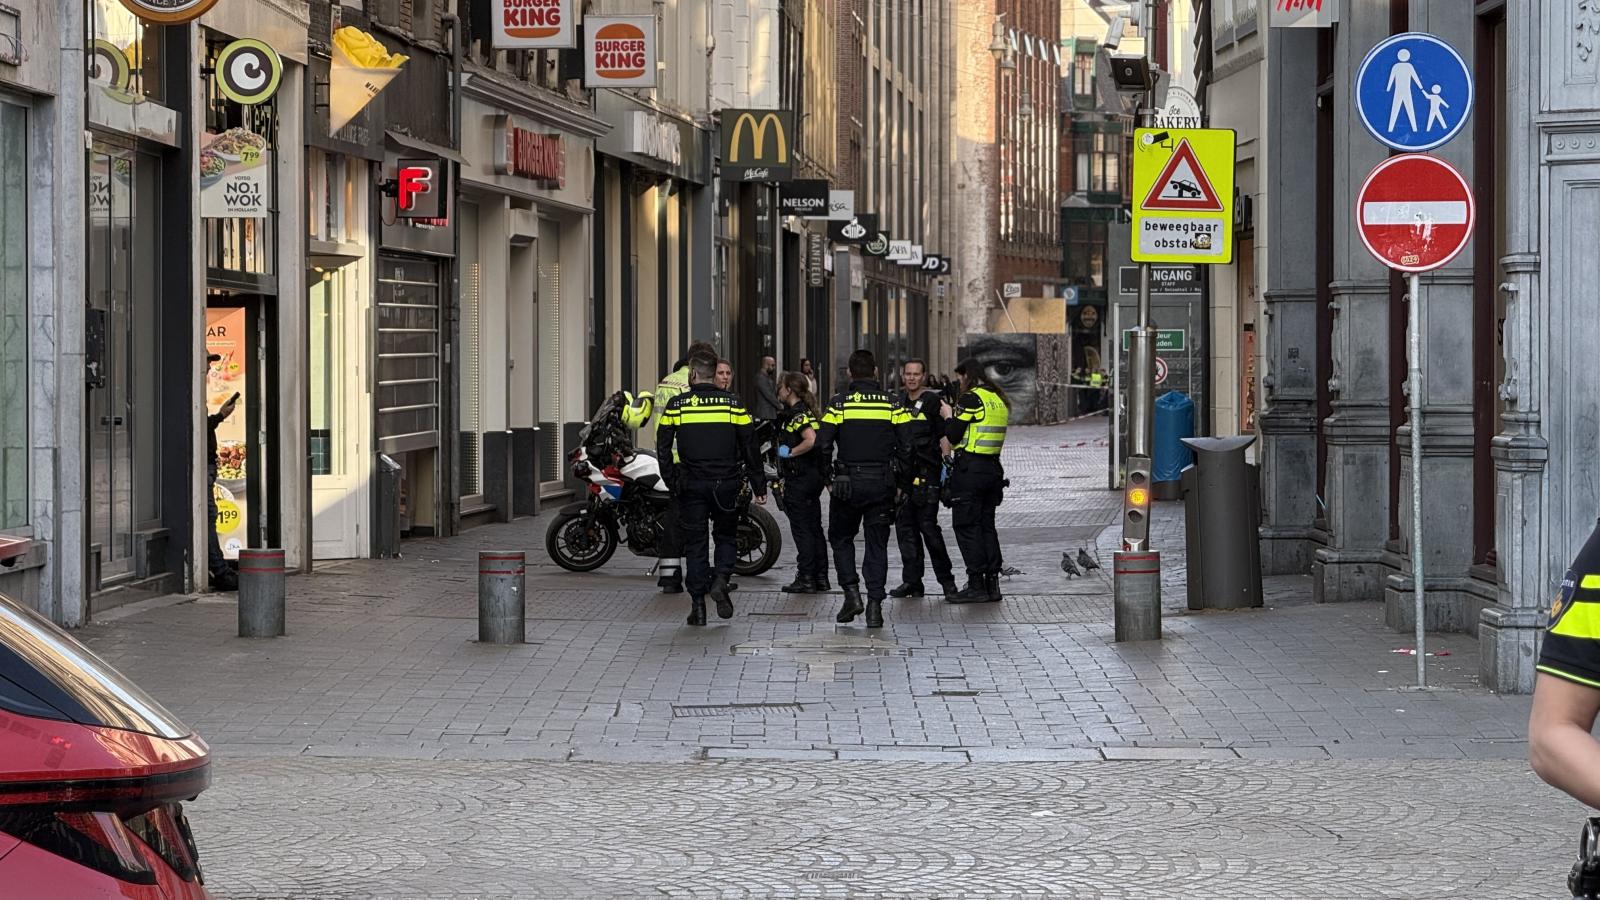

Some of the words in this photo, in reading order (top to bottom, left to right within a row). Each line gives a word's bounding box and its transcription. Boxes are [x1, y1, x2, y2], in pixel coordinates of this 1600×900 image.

[503, 8, 561, 27] KING
[595, 41, 646, 52] BURGER
[595, 53, 646, 69] KING
[226, 182, 259, 194] NO.1
[399, 166, 433, 211] F
[224, 194, 262, 206] WOK
[782, 198, 825, 208] NELSON
[1145, 221, 1219, 235] beweegbaar
[1154, 237, 1195, 249] obstak
[811, 234, 821, 285] MANFIELD
[922, 257, 940, 270] JD
[1151, 270, 1193, 281] NGANG
[206, 326, 226, 337] AR
